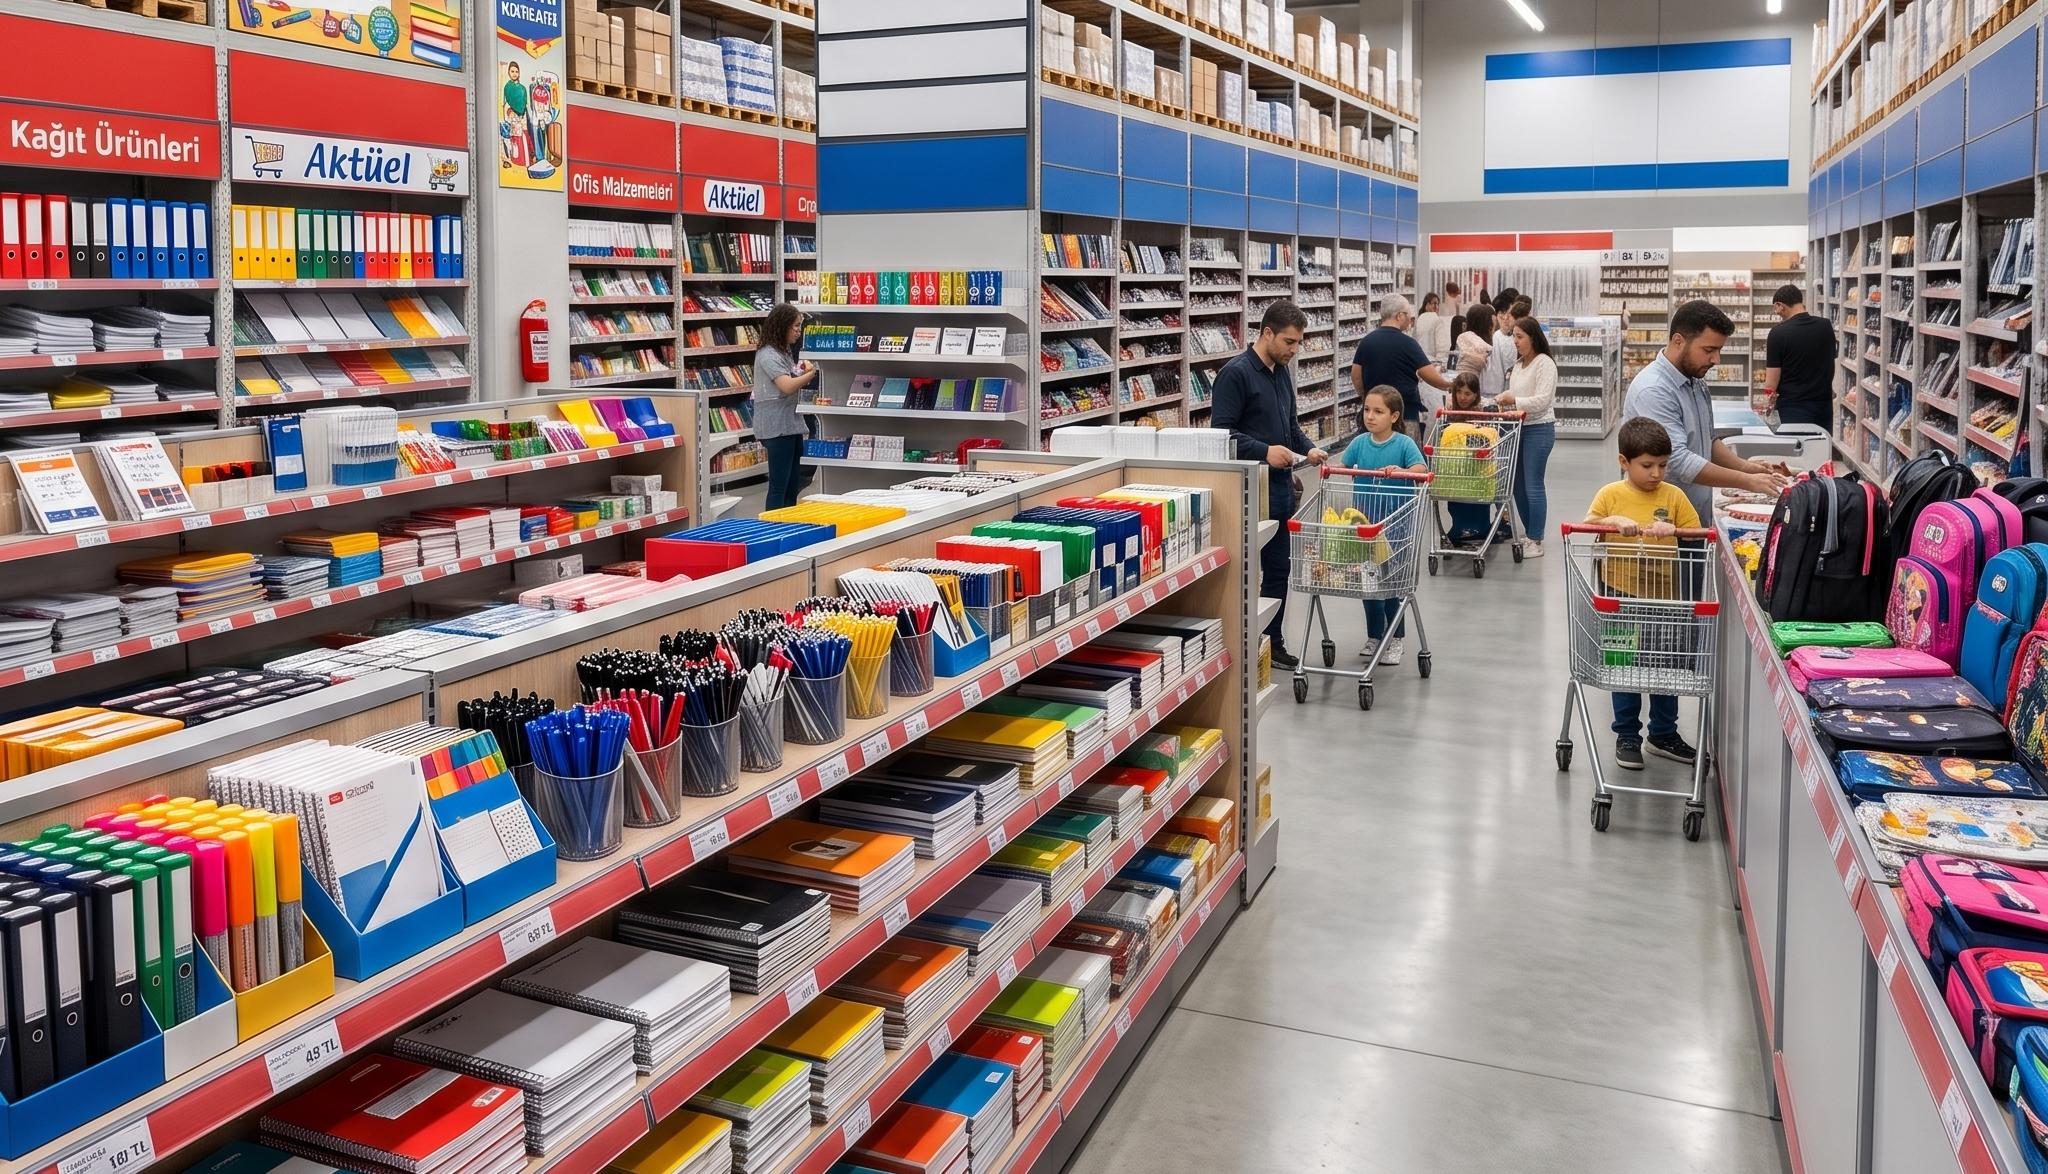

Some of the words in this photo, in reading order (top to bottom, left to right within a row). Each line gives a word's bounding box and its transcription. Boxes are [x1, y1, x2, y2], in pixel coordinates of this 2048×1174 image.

[11, 119, 87, 158] Kağıt
[95, 120, 200, 163] Ürünleri
[303, 142, 411, 185] Aktüel
[573, 173, 600, 195] Ofis
[708, 184, 760, 212] Aktüel
[320, 1038, 339, 1054] TL
